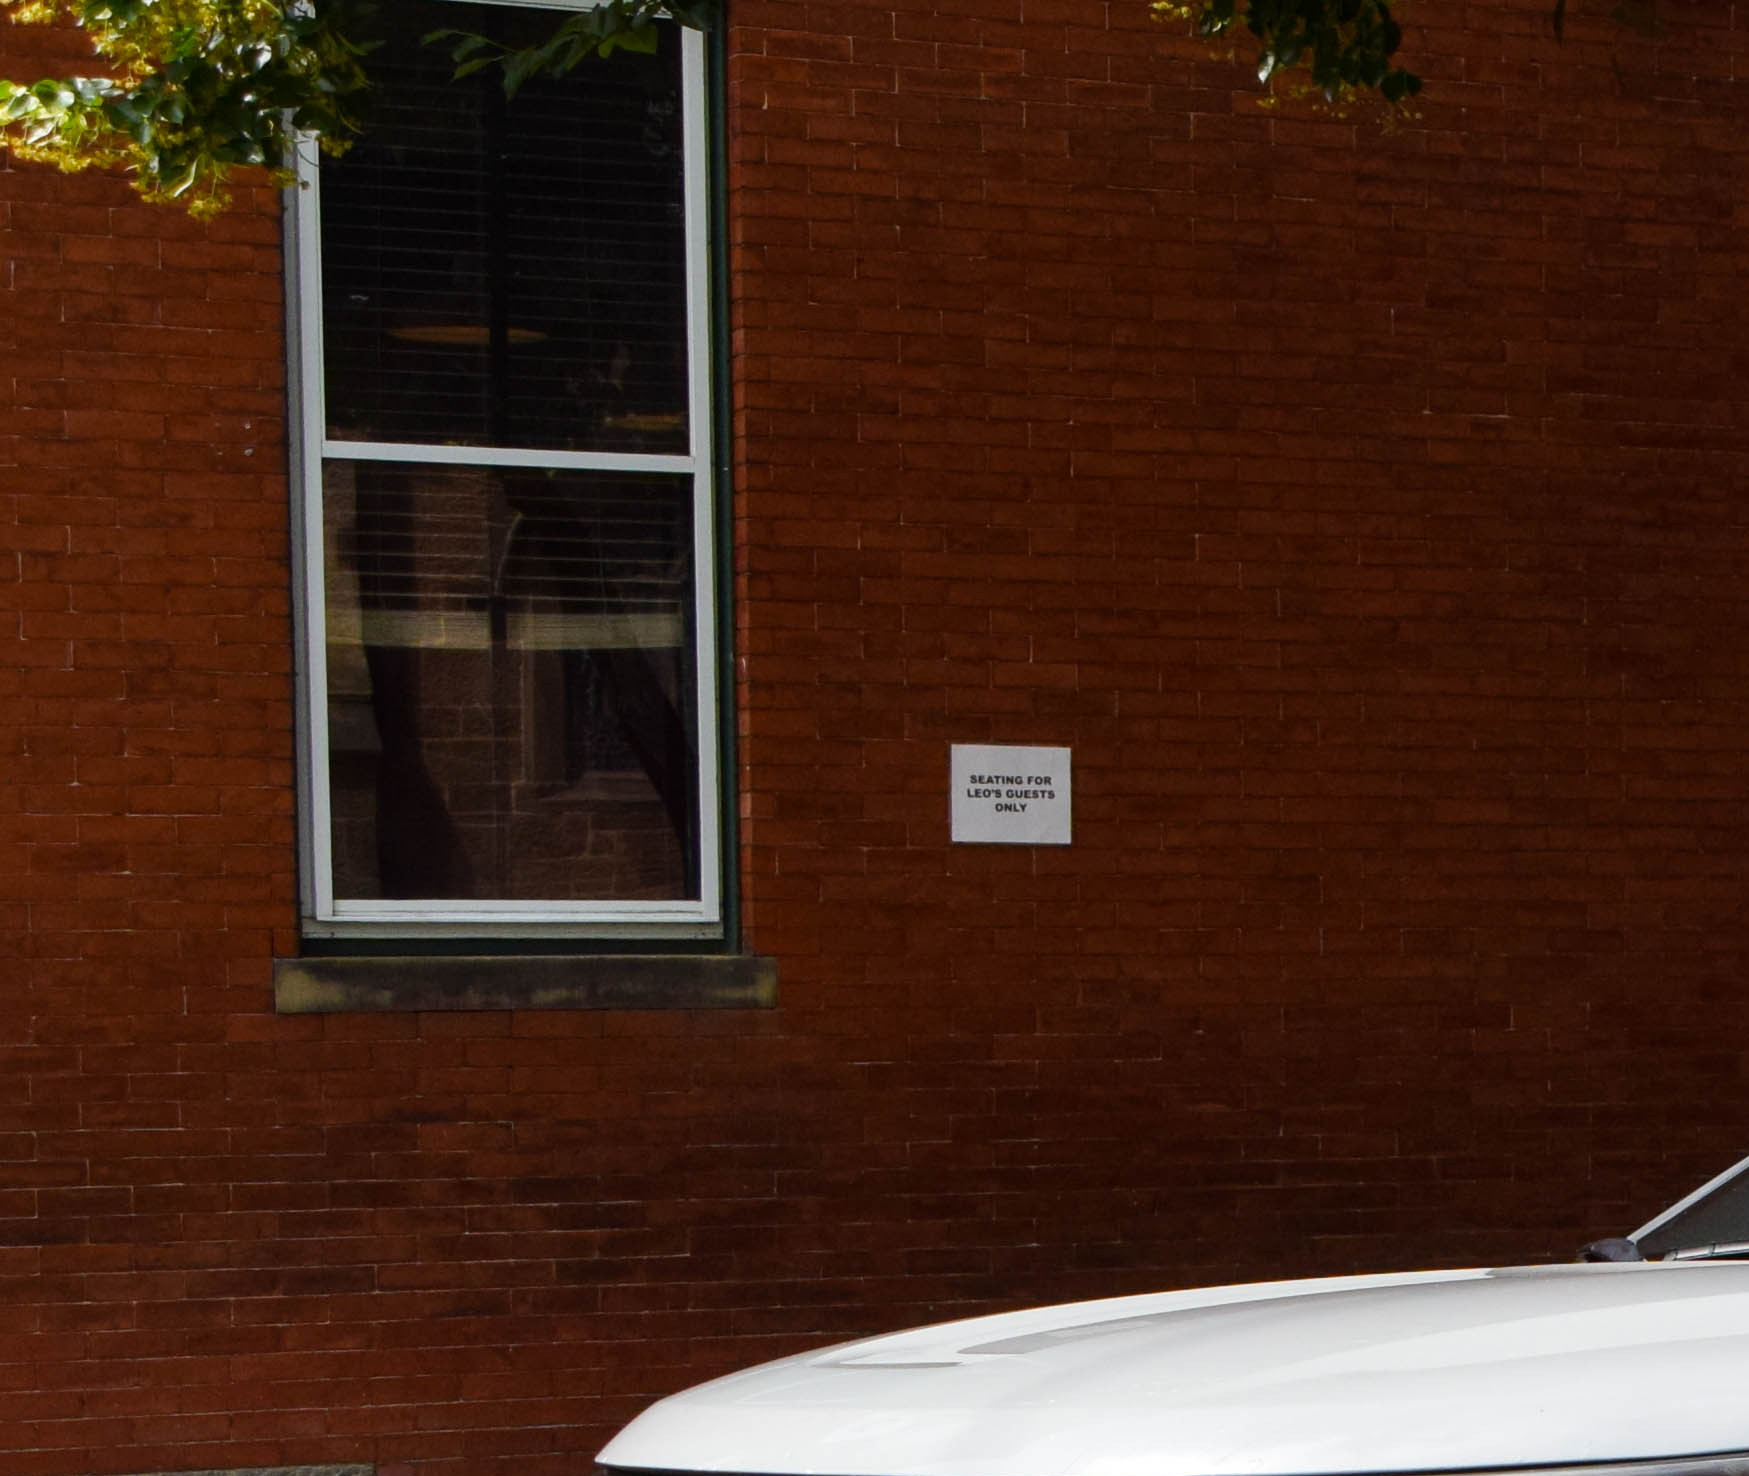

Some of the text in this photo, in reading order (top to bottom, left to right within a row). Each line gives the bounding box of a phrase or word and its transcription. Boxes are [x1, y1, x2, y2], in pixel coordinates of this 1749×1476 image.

[970, 774, 1052, 786] SEATING FOR
[967, 788, 1056, 800] LEO'S GUESTS
[995, 803, 1028, 813] ONLY
